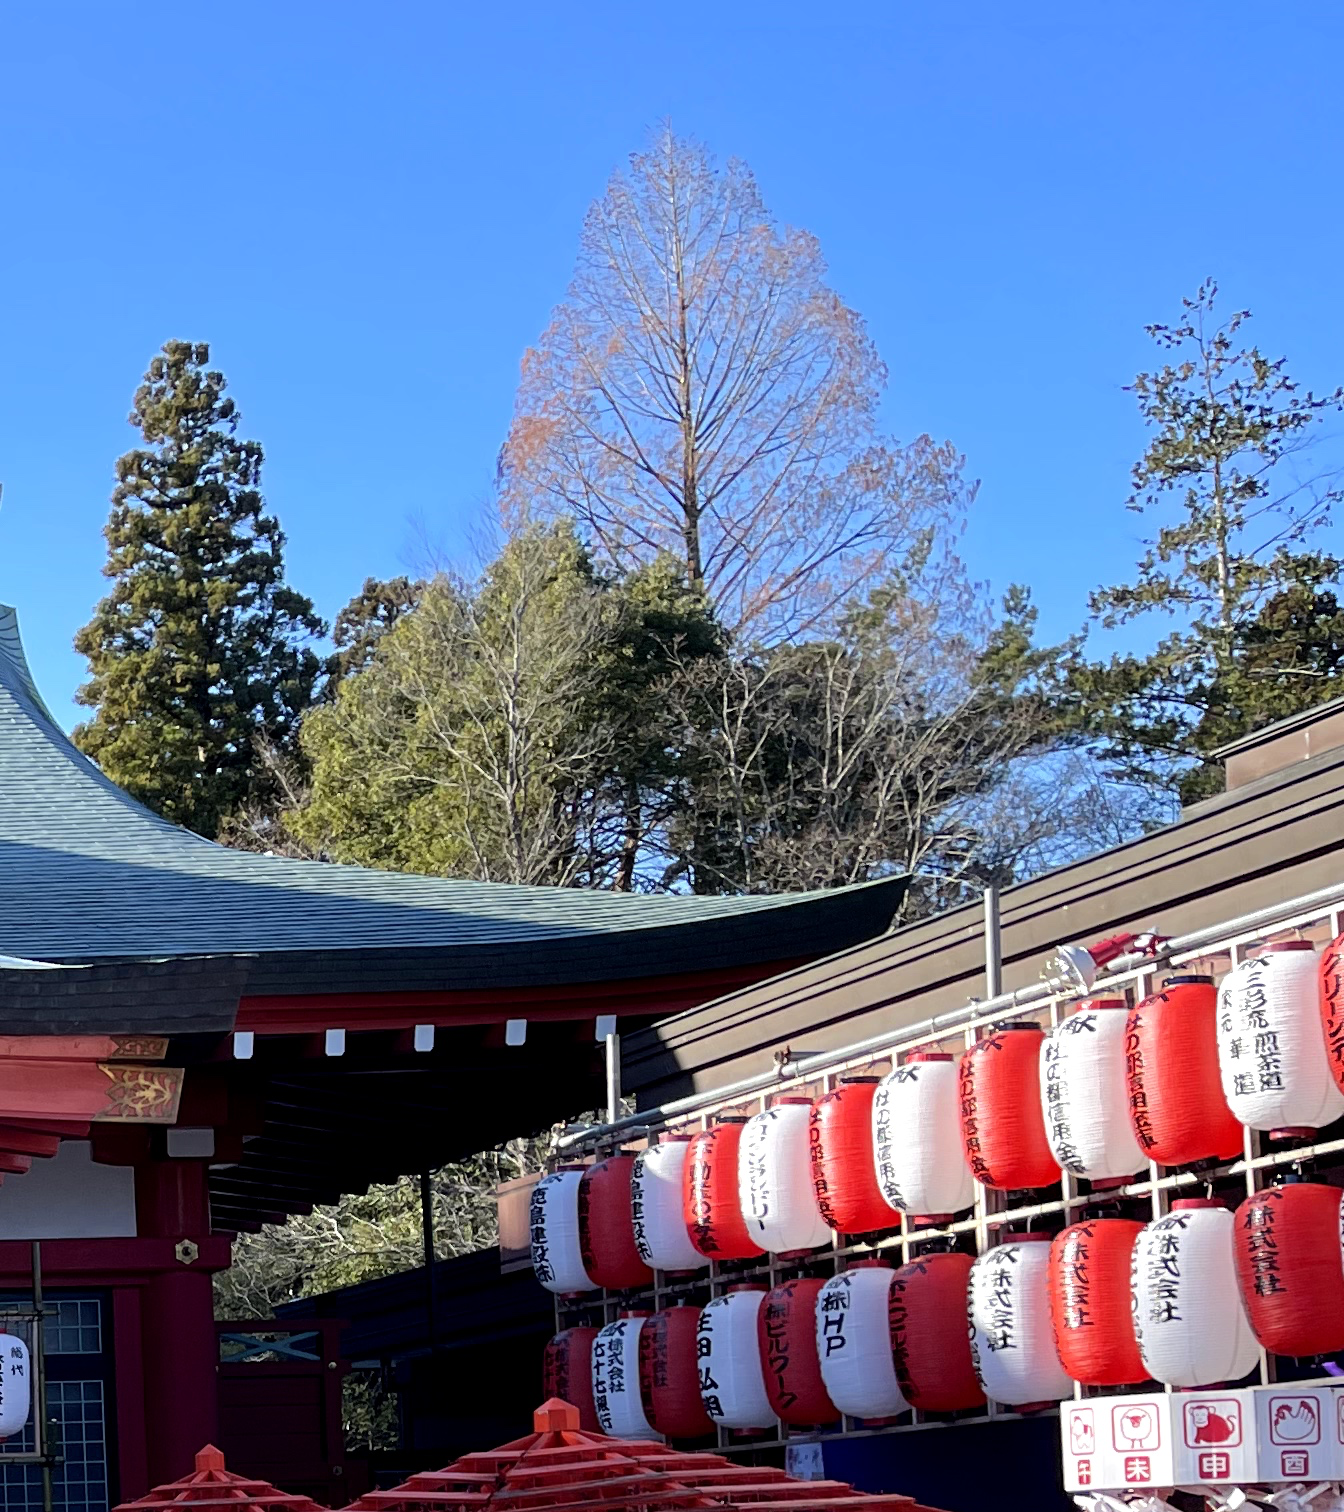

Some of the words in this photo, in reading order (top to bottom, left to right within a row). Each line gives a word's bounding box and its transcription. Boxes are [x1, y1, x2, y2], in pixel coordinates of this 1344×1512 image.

[1126, 1457, 1150, 1482] 未
[1201, 1454, 1228, 1479] 申
[1283, 1451, 1308, 1475] 酉
